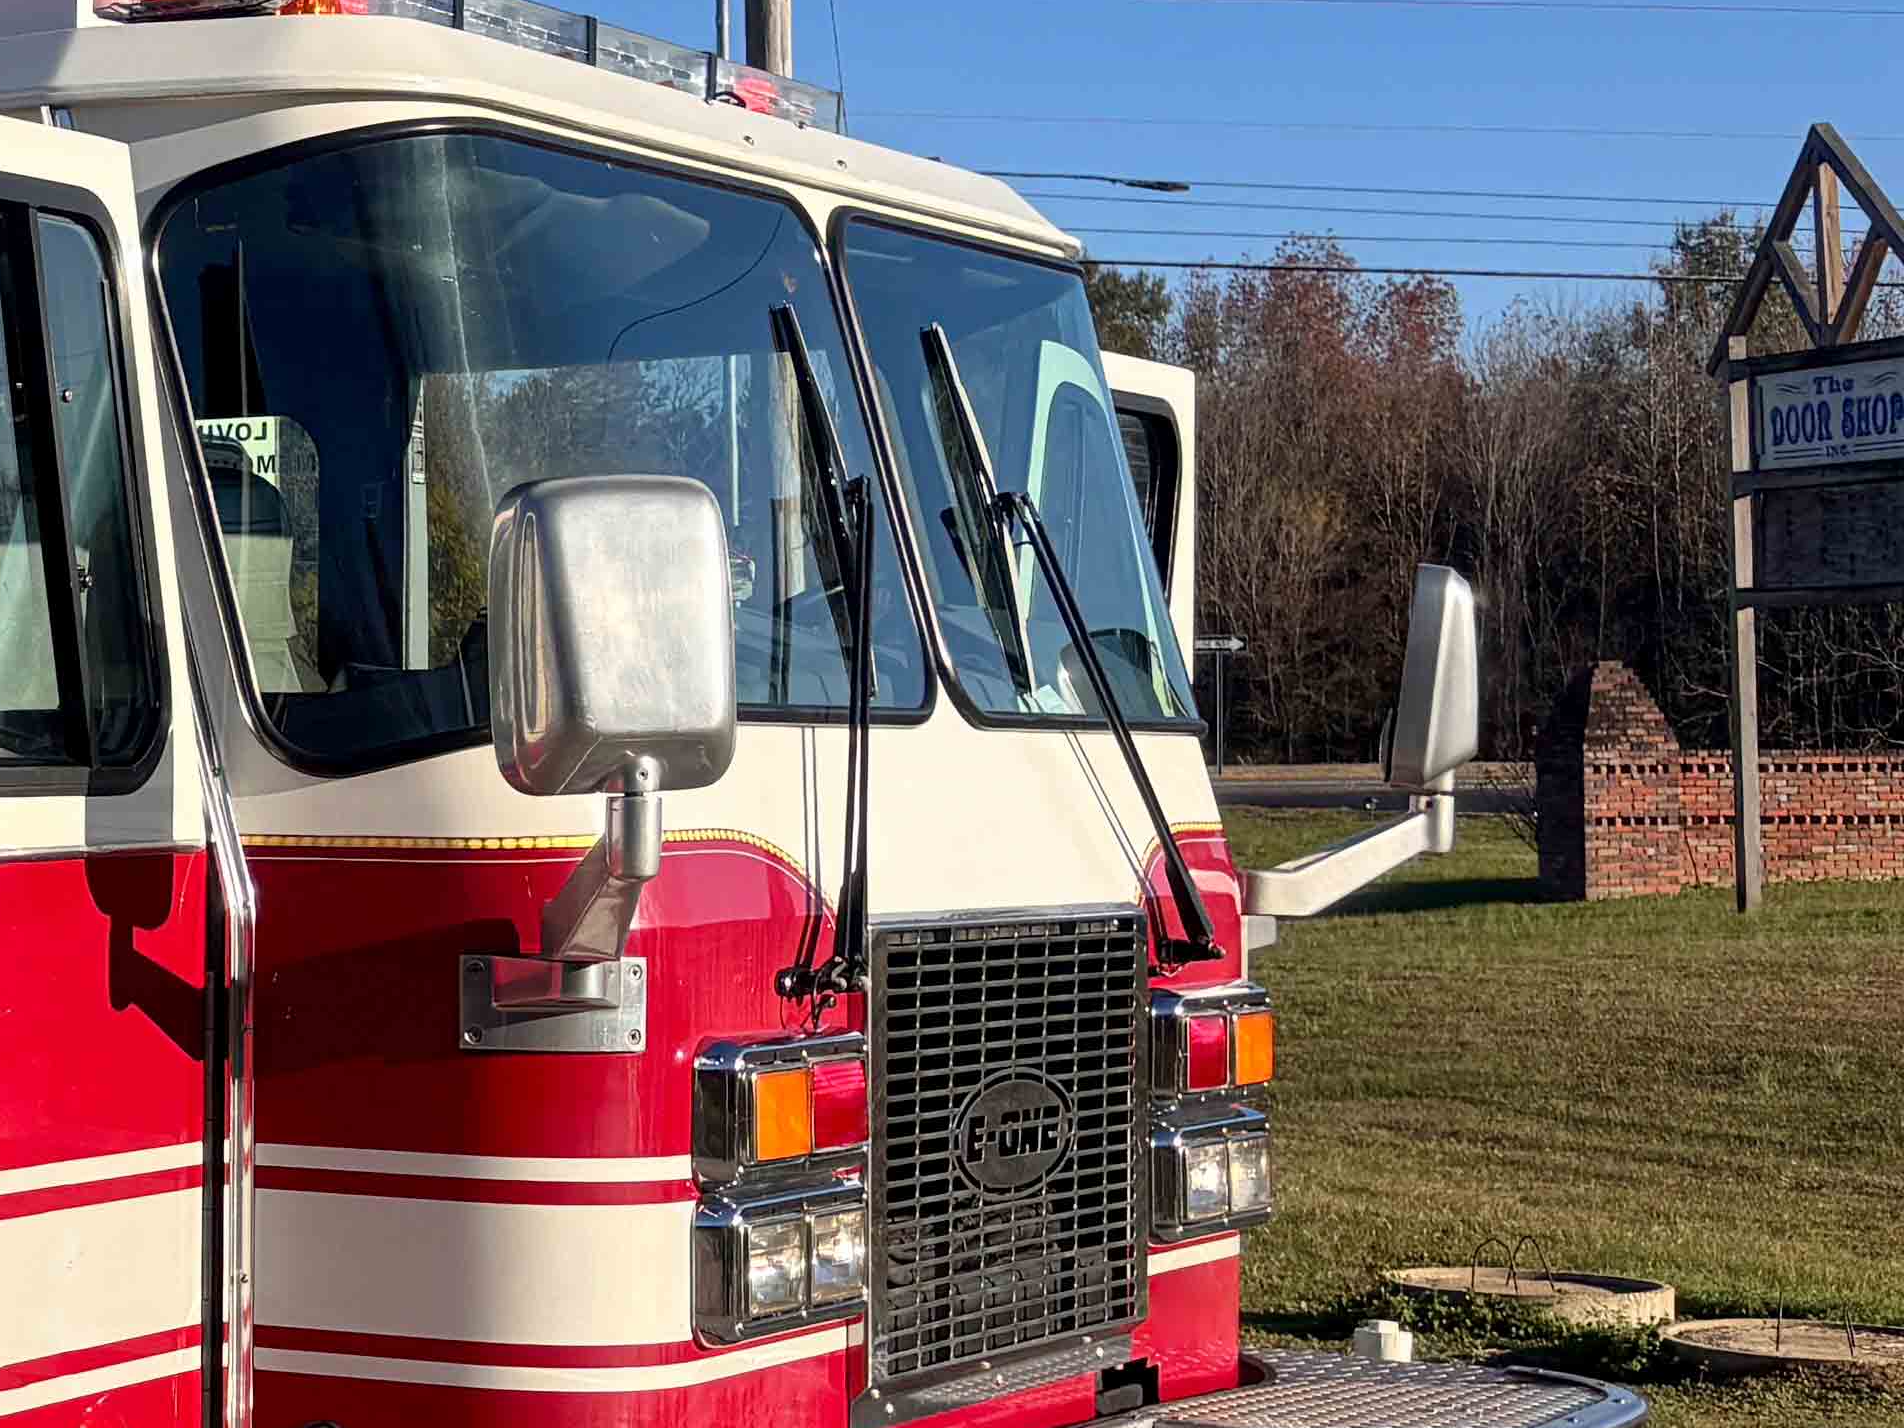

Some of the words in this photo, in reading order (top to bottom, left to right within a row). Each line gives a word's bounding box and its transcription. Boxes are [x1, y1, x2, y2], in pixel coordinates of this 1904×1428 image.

[1812, 375, 1855, 395] The
[1769, 400, 1833, 446] DOOR
[1842, 391, 1904, 439] SHOP
[966, 1104, 1060, 1164] E-ONE
